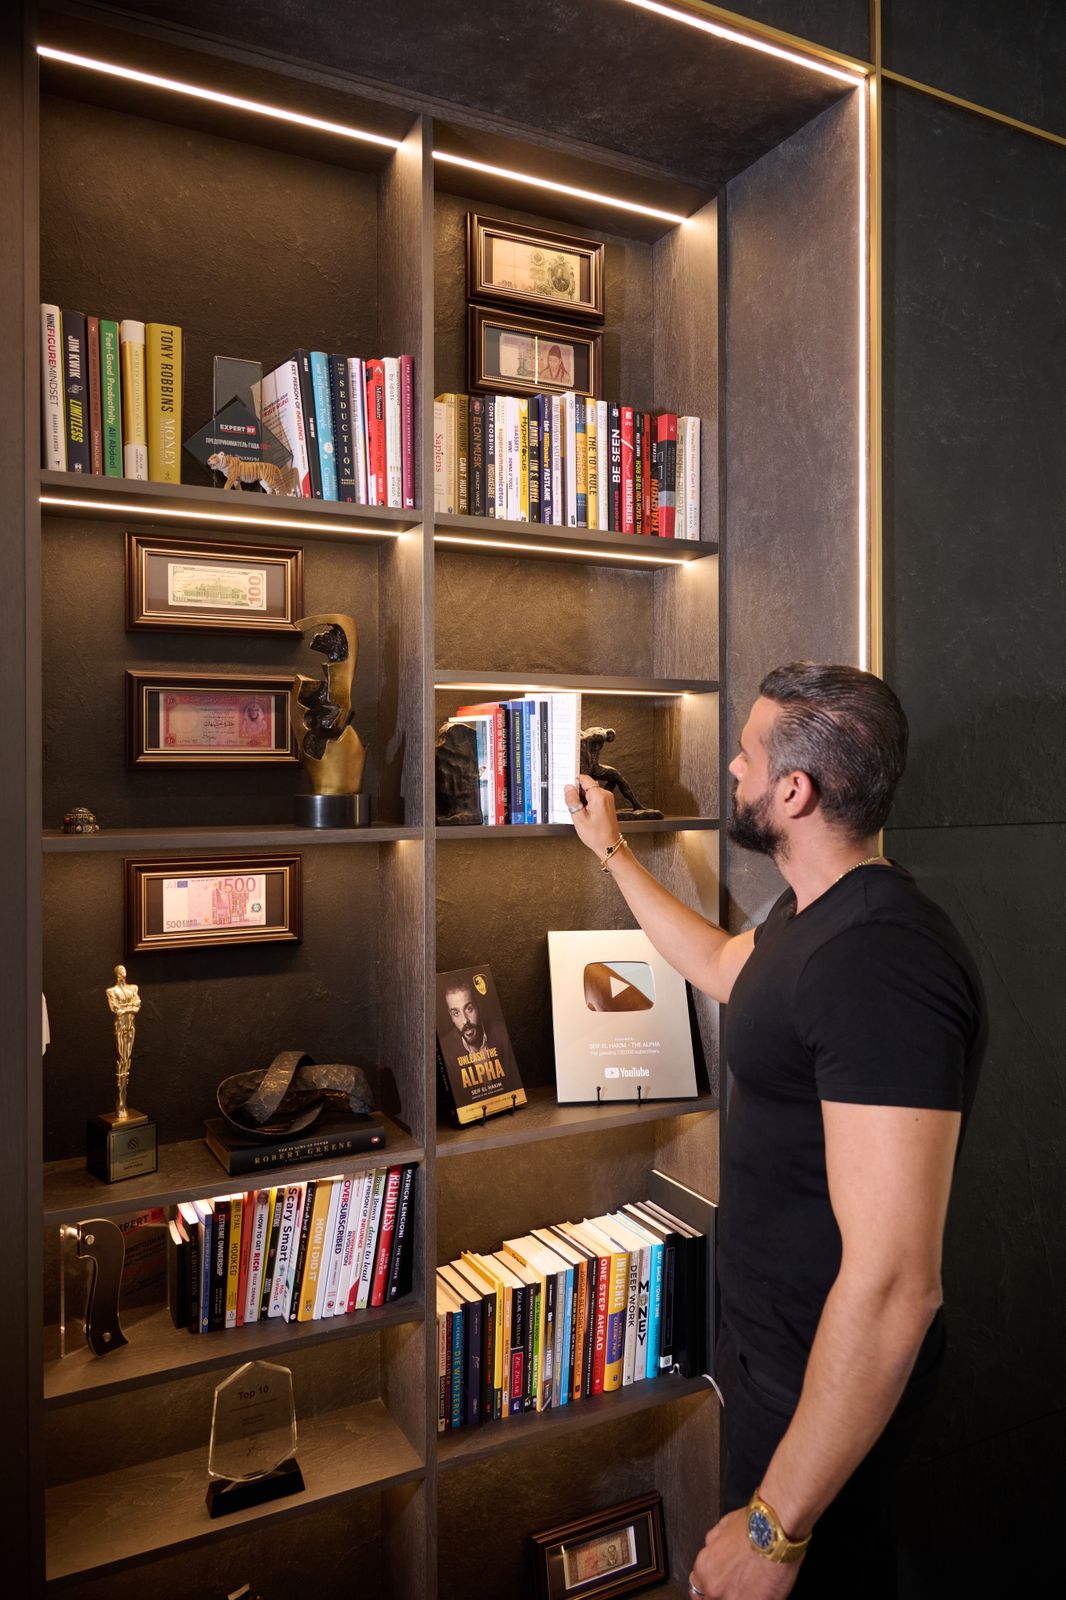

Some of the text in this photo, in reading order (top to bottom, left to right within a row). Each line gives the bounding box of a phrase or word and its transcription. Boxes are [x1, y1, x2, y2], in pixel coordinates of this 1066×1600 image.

[105, 332, 114, 376] Feel-Good
[161, 330, 174, 360] TONY
[68, 336, 83, 443] JIM KWIK LIMITLESS
[161, 363, 174, 413] ROBBINS
[388, 373, 395, 382] by
[107, 378, 116, 425] Productivity
[295, 401, 301, 410] OF
[317, 375, 329, 430] Influence People
[220, 424, 246, 432] EXPERT
[296, 410, 304, 442] INFLUENCE
[473, 417, 481, 440] ELON
[529, 421, 539, 447] WINNING
[109, 440, 117, 469] Abdaal
[164, 418, 176, 469] MONEY
[206, 437, 248, 448] ПРЕДПРИНИМАТЕЛЬ
[434, 432, 444, 473] Sapiens
[474, 442, 482, 468] MUSK
[521, 416, 529, 472] Hyperfocus
[588, 436, 598, 496] THE 10X RULE
[611, 429, 620, 483] BE SEEN
[459, 480, 467, 496] HURT
[635, 474, 641, 483] BE
[636, 483, 642, 491] TO
[460, 499, 467, 509] ME
[625, 479, 633, 523] ENTREPRENEUR
[248, 576, 262, 605] 100
[224, 877, 256, 893] 500
[457, 1047, 499, 1067] UNLEASH THE
[460, 1058, 505, 1089] ALPHA
[619, 1067, 650, 1078] YouTube
[471, 1087, 482, 1096] SEIF
[254, 1141, 353, 1165] ROBERT GREENE
[364, 1185, 372, 1209] PERSON
[403, 1169, 412, 1201] PATRICK
[362, 1209, 368, 1218] OF
[371, 1198, 380, 1221] Brown
[383, 1174, 401, 1232] RELENTLESS
[257, 1213, 265, 1229] HOW
[279, 1187, 298, 1262] Scary Smart
[313, 1218, 325, 1243] HOW
[335, 1180, 351, 1255] OVERSUBSCRIBED
[398, 1202, 408, 1238] LENCIONI
[216, 1214, 226, 1276] EXTREME OWNERSHIP
[256, 1230, 263, 1239] TO
[357, 1218, 367, 1249] INFLUENCE
[366, 1226, 377, 1249] dare
[230, 1243, 239, 1276] HOOKED
[310, 1251, 320, 1270] DID
[343, 1230, 353, 1266] REVOLUTION
[365, 1250, 374, 1260] to
[252, 1252, 261, 1271] RICH
[360, 1262, 371, 1282] lead
[378, 1247, 386, 1276] GROVER
[393, 1255, 401, 1280] MOTIVE
[273, 1277, 281, 1301] Gawdat
[307, 1271, 316, 1281] IT
[614, 1258, 627, 1308] INFLUENCE
[596, 1258, 608, 1351] ONE STEP AHEAD
[628, 1264, 638, 1328] DEEP WORK
